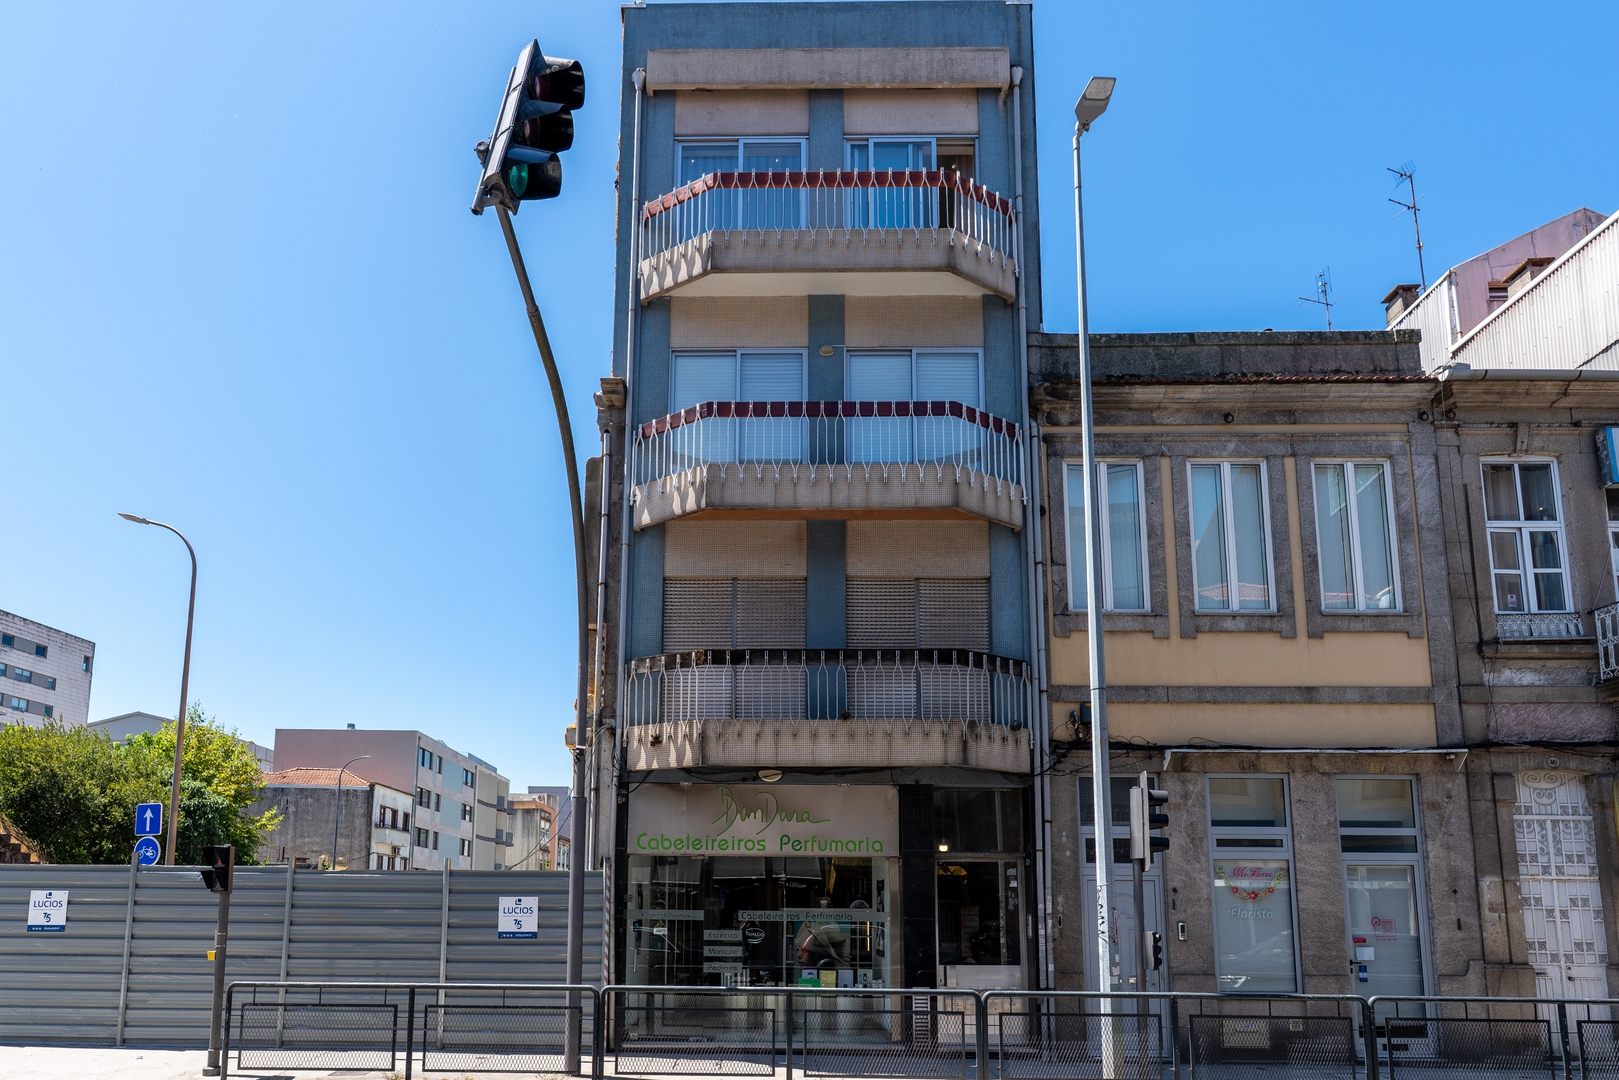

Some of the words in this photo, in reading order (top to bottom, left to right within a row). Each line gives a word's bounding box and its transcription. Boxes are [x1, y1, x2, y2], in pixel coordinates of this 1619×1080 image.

[1369, 763, 1385, 772] 539
[636, 832, 766, 852] Cabeleireiros
[780, 834, 884, 853] Perfumaria
[33, 900, 63, 908] LUCIOS
[503, 906, 534, 915] LUCIOS
[1231, 908, 1273, 919] Florista
[741, 911, 800, 921] Cabeleireros
[708, 931, 738, 939] Estética
